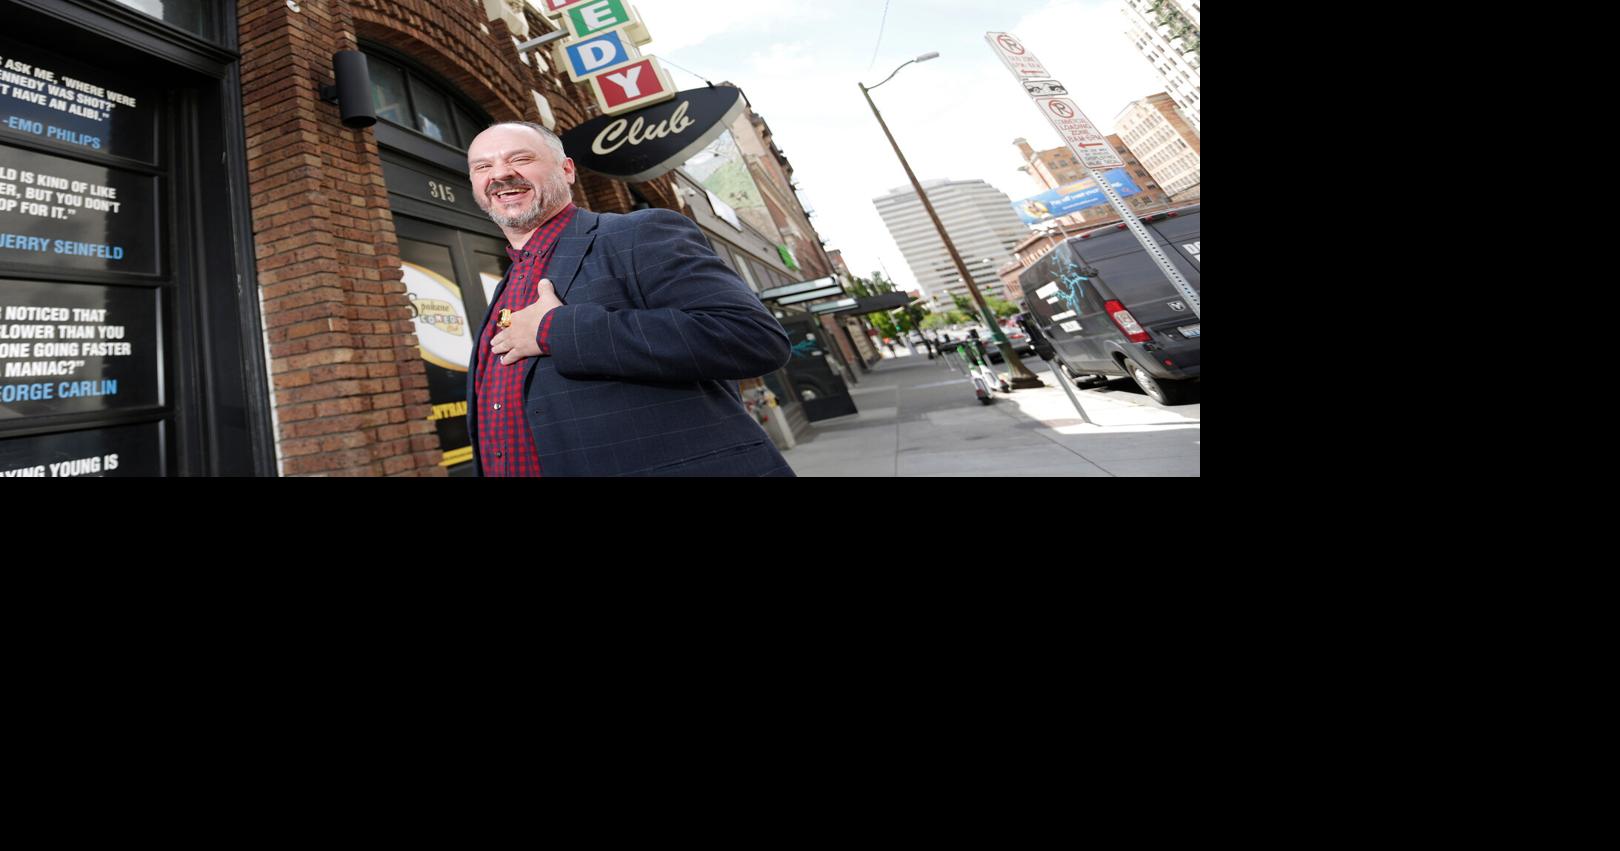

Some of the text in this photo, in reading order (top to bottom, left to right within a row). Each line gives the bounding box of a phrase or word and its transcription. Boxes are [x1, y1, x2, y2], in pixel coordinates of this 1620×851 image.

[556, 0, 642, 99] EDY
[4, 58, 32, 75] ASK
[34, 67, 58, 85] ME,
[106, 90, 137, 108] WERE
[48, 84, 75, 101] WAS
[12, 86, 48, 106] HAVE
[48, 97, 68, 112] AN
[47, 126, 101, 150] PHILIPS
[591, 100, 695, 155] Club
[20, 170, 34, 184] IS
[37, 174, 69, 190] KIND
[71, 180, 89, 194] OF
[90, 184, 116, 199] LIKE
[428, 180, 456, 203] 315
[20, 201, 48, 217] FOR
[25, 187, 53, 202] BUT
[56, 191, 82, 207] YOU
[84, 197, 121, 214] DON'T
[54, 239, 124, 260] SEINFELD
[5, 306, 106, 322] NOTICED THAT
[58, 325, 95, 339] THAN
[97, 326, 125, 340] YOU
[33, 343, 79, 357] GOING
[82, 342, 131, 356] FASTER
[0, 379, 117, 403] ORGE CARLIN
[49, 456, 101, 477] YOUNG
[103, 453, 119, 470] IS
